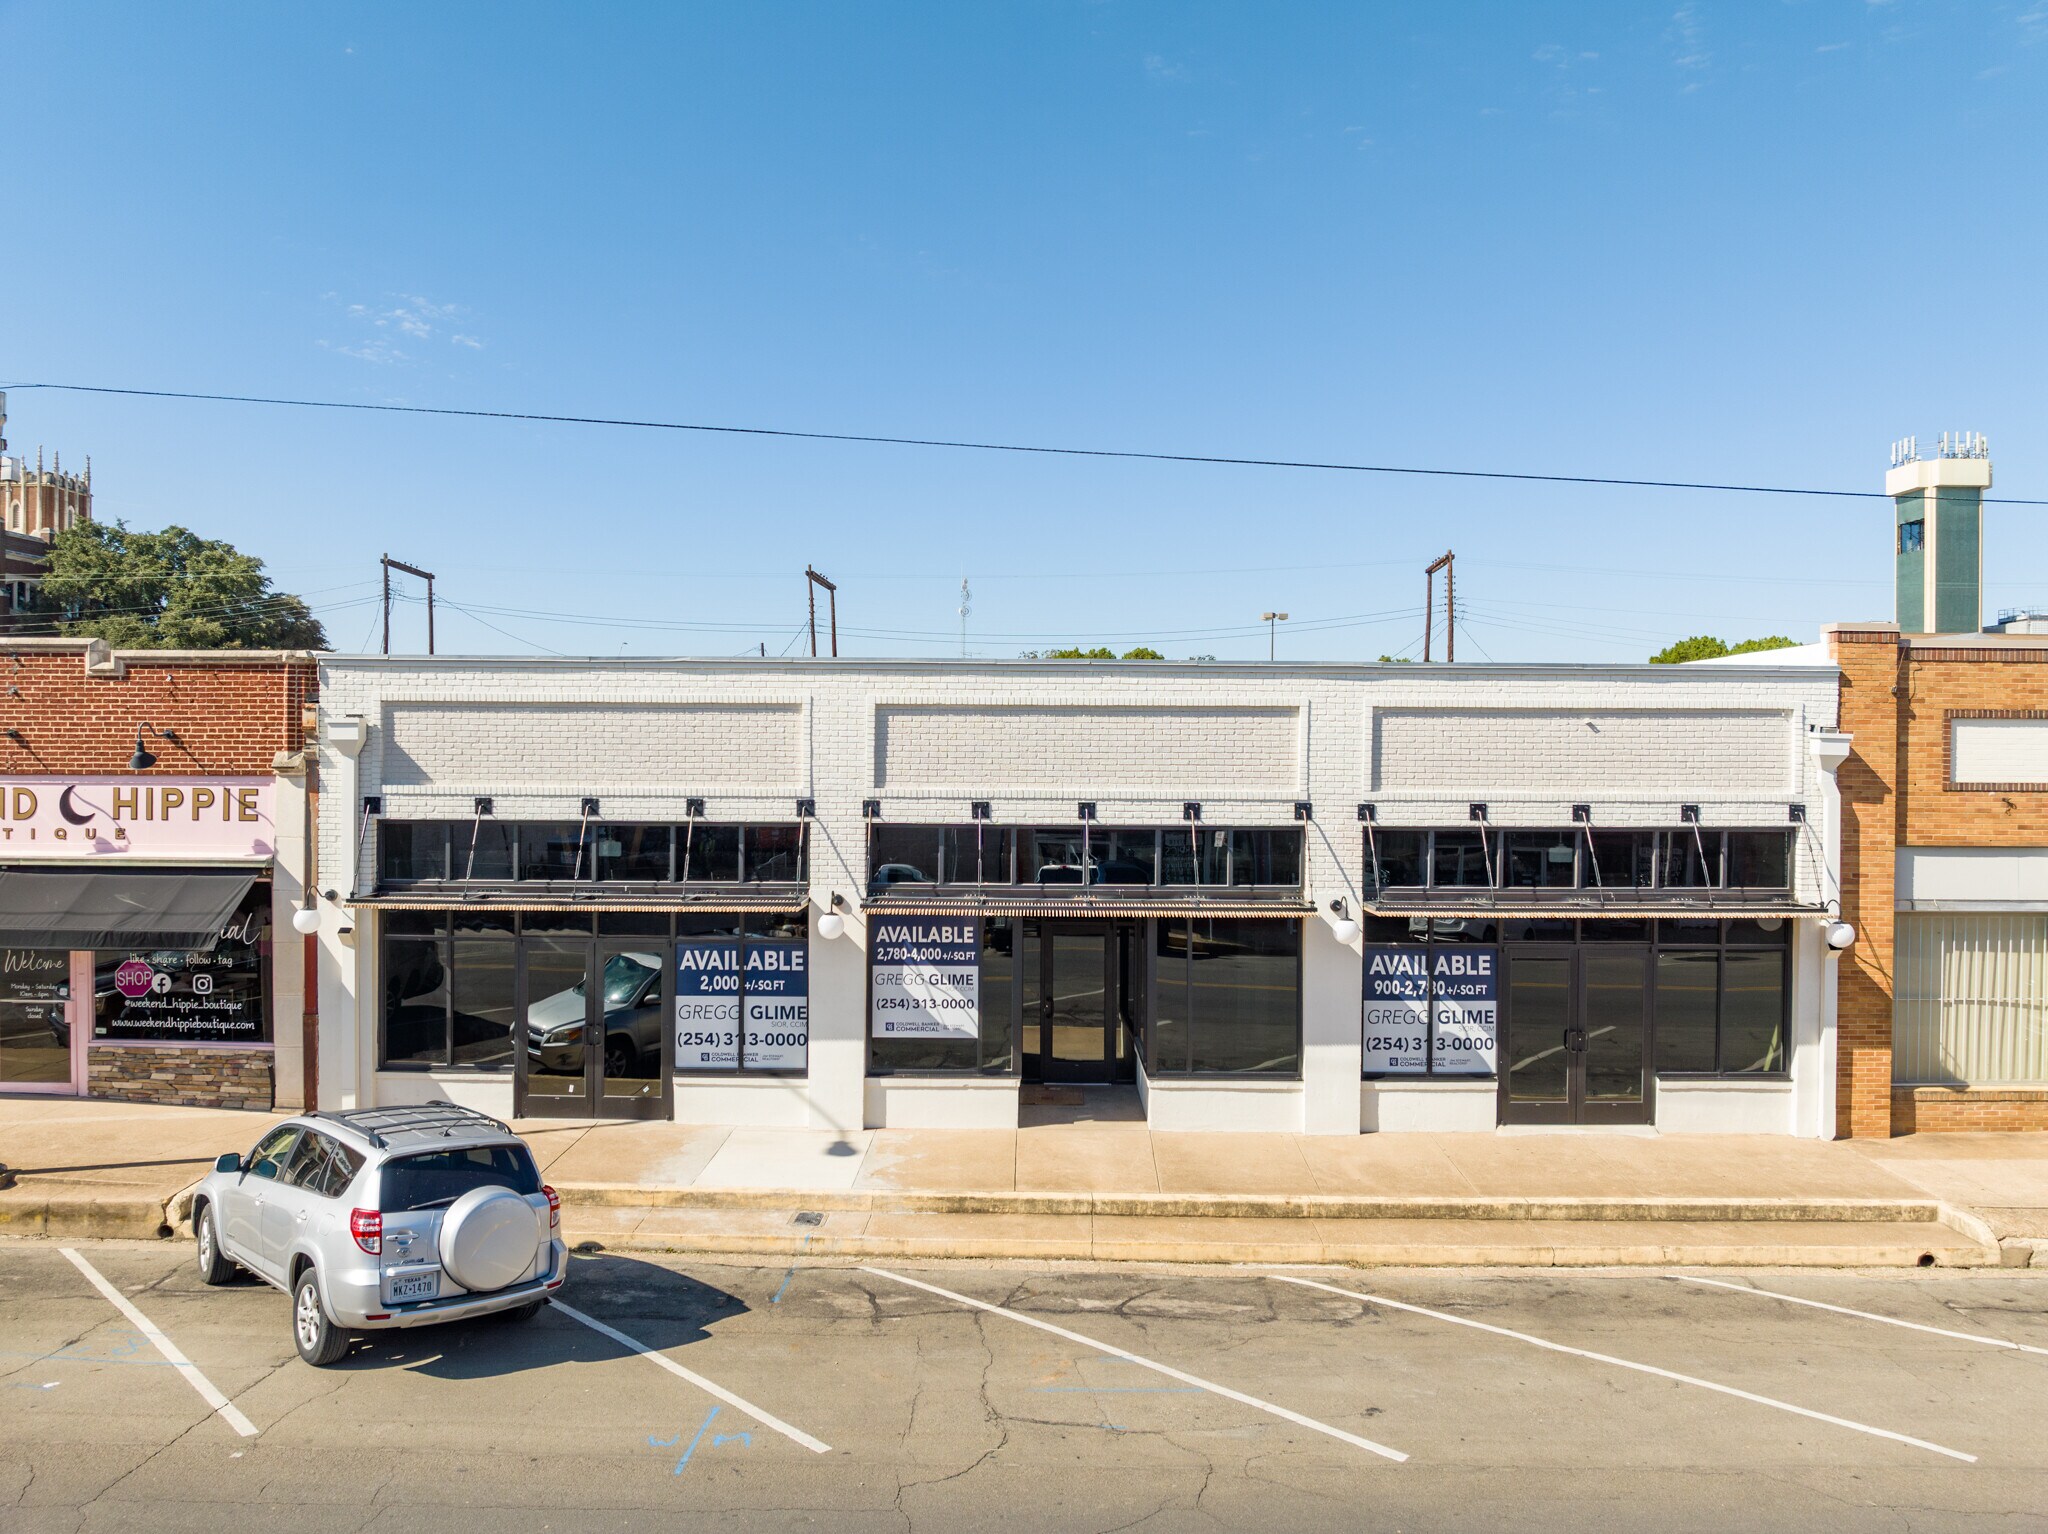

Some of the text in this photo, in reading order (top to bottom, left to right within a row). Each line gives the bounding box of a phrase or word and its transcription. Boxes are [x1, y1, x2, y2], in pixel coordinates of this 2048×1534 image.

[112, 787, 259, 822] HIPPIE
[3, 828, 126, 840] TIQUE
[876, 926, 974, 943] AVAILABLE
[4, 949, 65, 973] Welcome
[151, 953, 177, 964] share
[186, 953, 211, 967] follow
[218, 955, 233, 967] tag
[679, 950, 804, 971] AVAILABLE
[877, 948, 941, 961] 2,780-4,000
[1369, 955, 1491, 975] AVAILABLE
[117, 972, 152, 986] SHOP
[700, 975, 739, 992] 2,000
[875, 973, 974, 986] GREGG GLIME
[25, 1005, 44, 1013] Sunday
[678, 1004, 808, 1020] GREGG GLIME
[876, 998, 975, 1011] (254) 313-0000
[112, 1016, 256, 1034] www.weekendhippieboutique.com
[1367, 1009, 1495, 1025] GREGG GLIME
[677, 1032, 721, 1048] (254)
[1366, 1037, 1409, 1053] (254)
